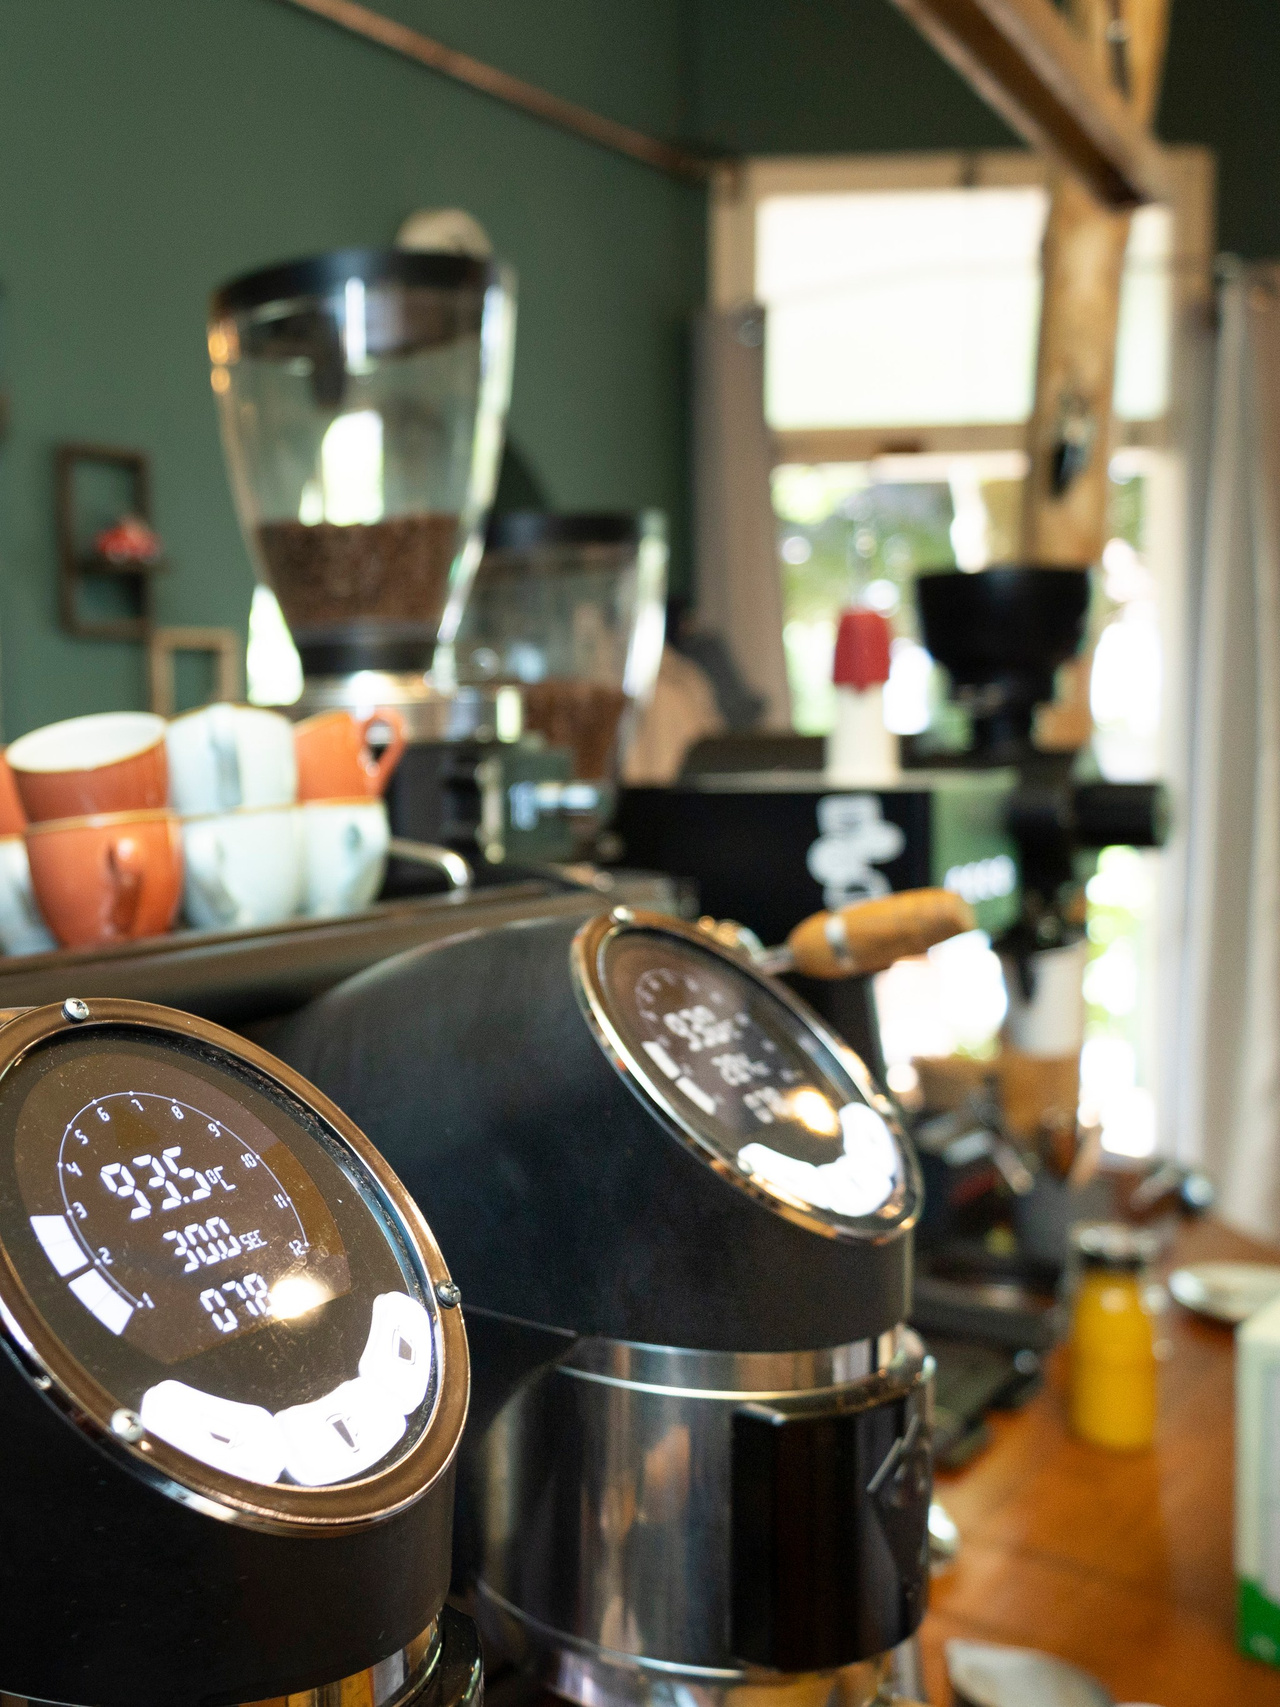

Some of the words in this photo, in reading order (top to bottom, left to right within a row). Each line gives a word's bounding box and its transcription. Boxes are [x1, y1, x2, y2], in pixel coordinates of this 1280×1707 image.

[131, 1099, 144, 1112] 7
[171, 1105, 184, 1120] 8
[96, 1106, 110, 1122] 6
[74, 1129, 89, 1145] 5
[207, 1122, 221, 1137] 9
[240, 1152, 258, 1169] 10
[66, 1161, 83, 1177] 4
[273, 1193, 289, 1209] 11
[72, 1201, 88, 1219] 3
[238, 1229, 268, 1251] SEC
[288, 1239, 306, 1257] 12
[98, 1247, 114, 1266] 2
[142, 1292, 155, 1309] 1
